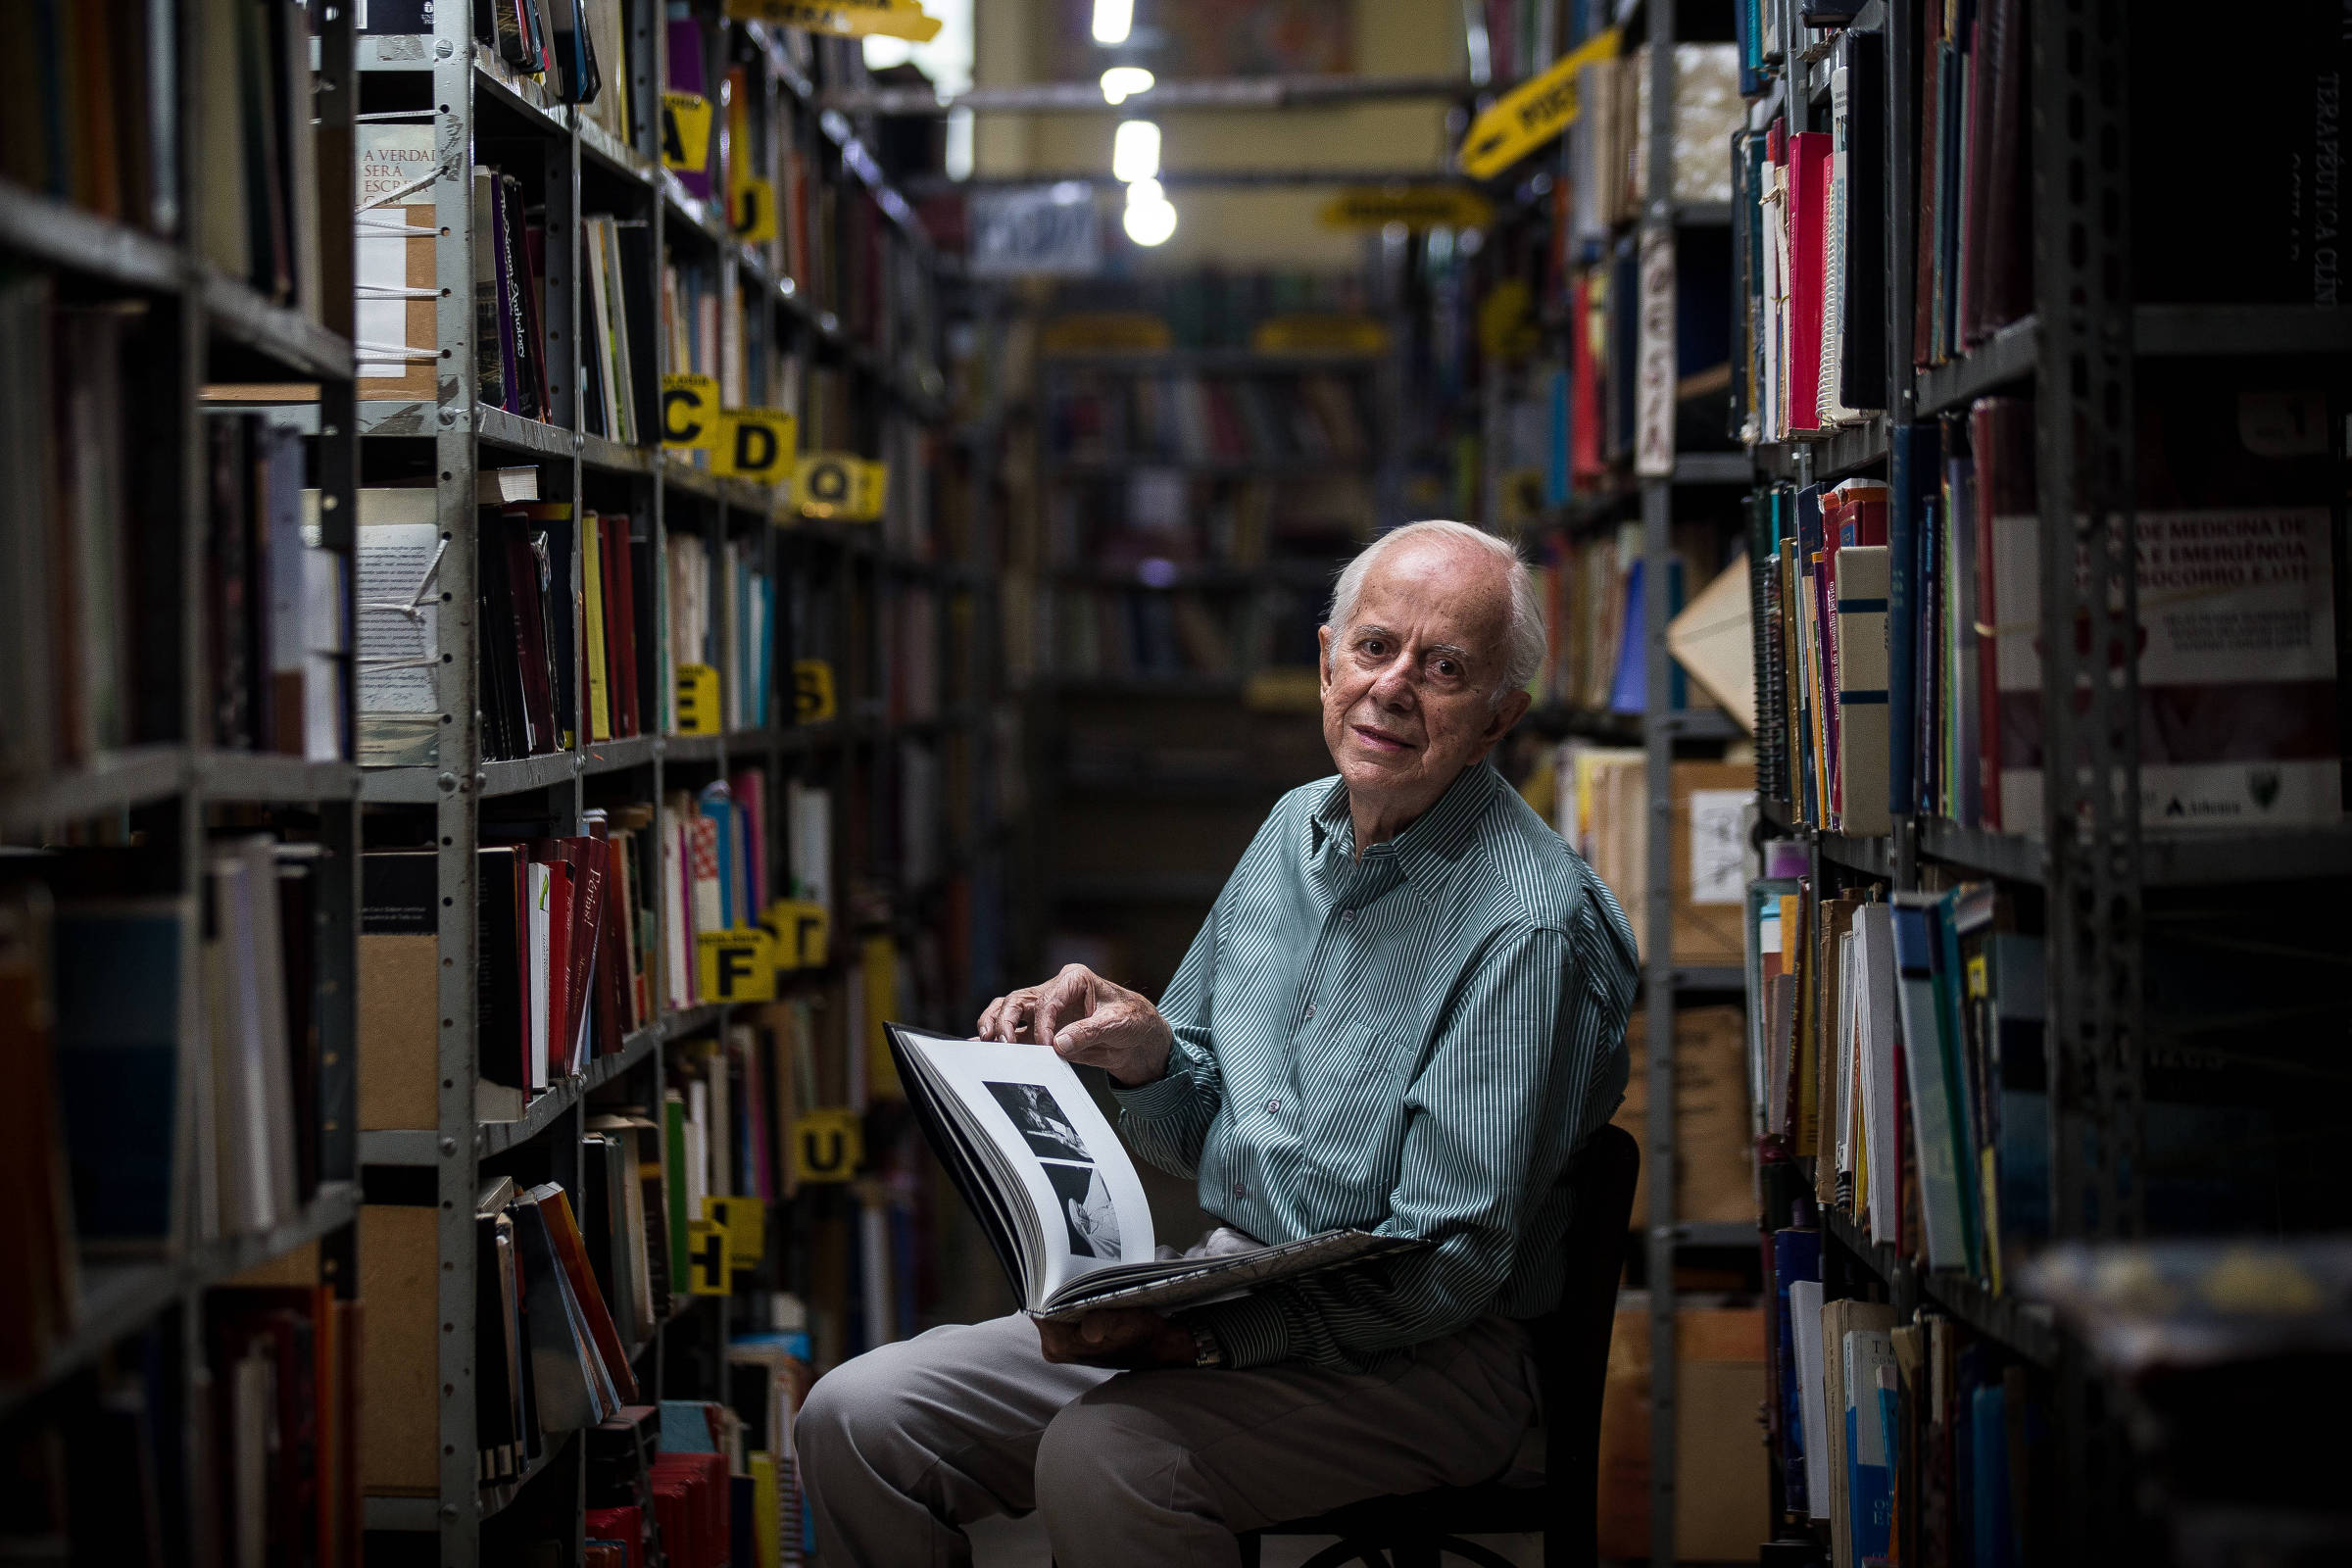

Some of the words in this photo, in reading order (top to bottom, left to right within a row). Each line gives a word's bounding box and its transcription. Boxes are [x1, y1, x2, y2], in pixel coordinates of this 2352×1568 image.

[363, 150, 374, 161] A
[365, 163, 402, 176] SERÁ
[736, 192, 756, 234] J
[510, 281, 525, 358] Anthology
[662, 390, 701, 441] C
[737, 425, 777, 468] D
[811, 464, 847, 502] Q
[2170, 518, 2273, 538] MEDICINA
[2280, 517, 2306, 535] DE
[2170, 539, 2307, 564] EMERGÊNCIA
[1830, 612, 1838, 652] assoalho
[583, 868, 601, 928] Férias!
[719, 949, 754, 996] F
[807, 1134, 842, 1170] U
